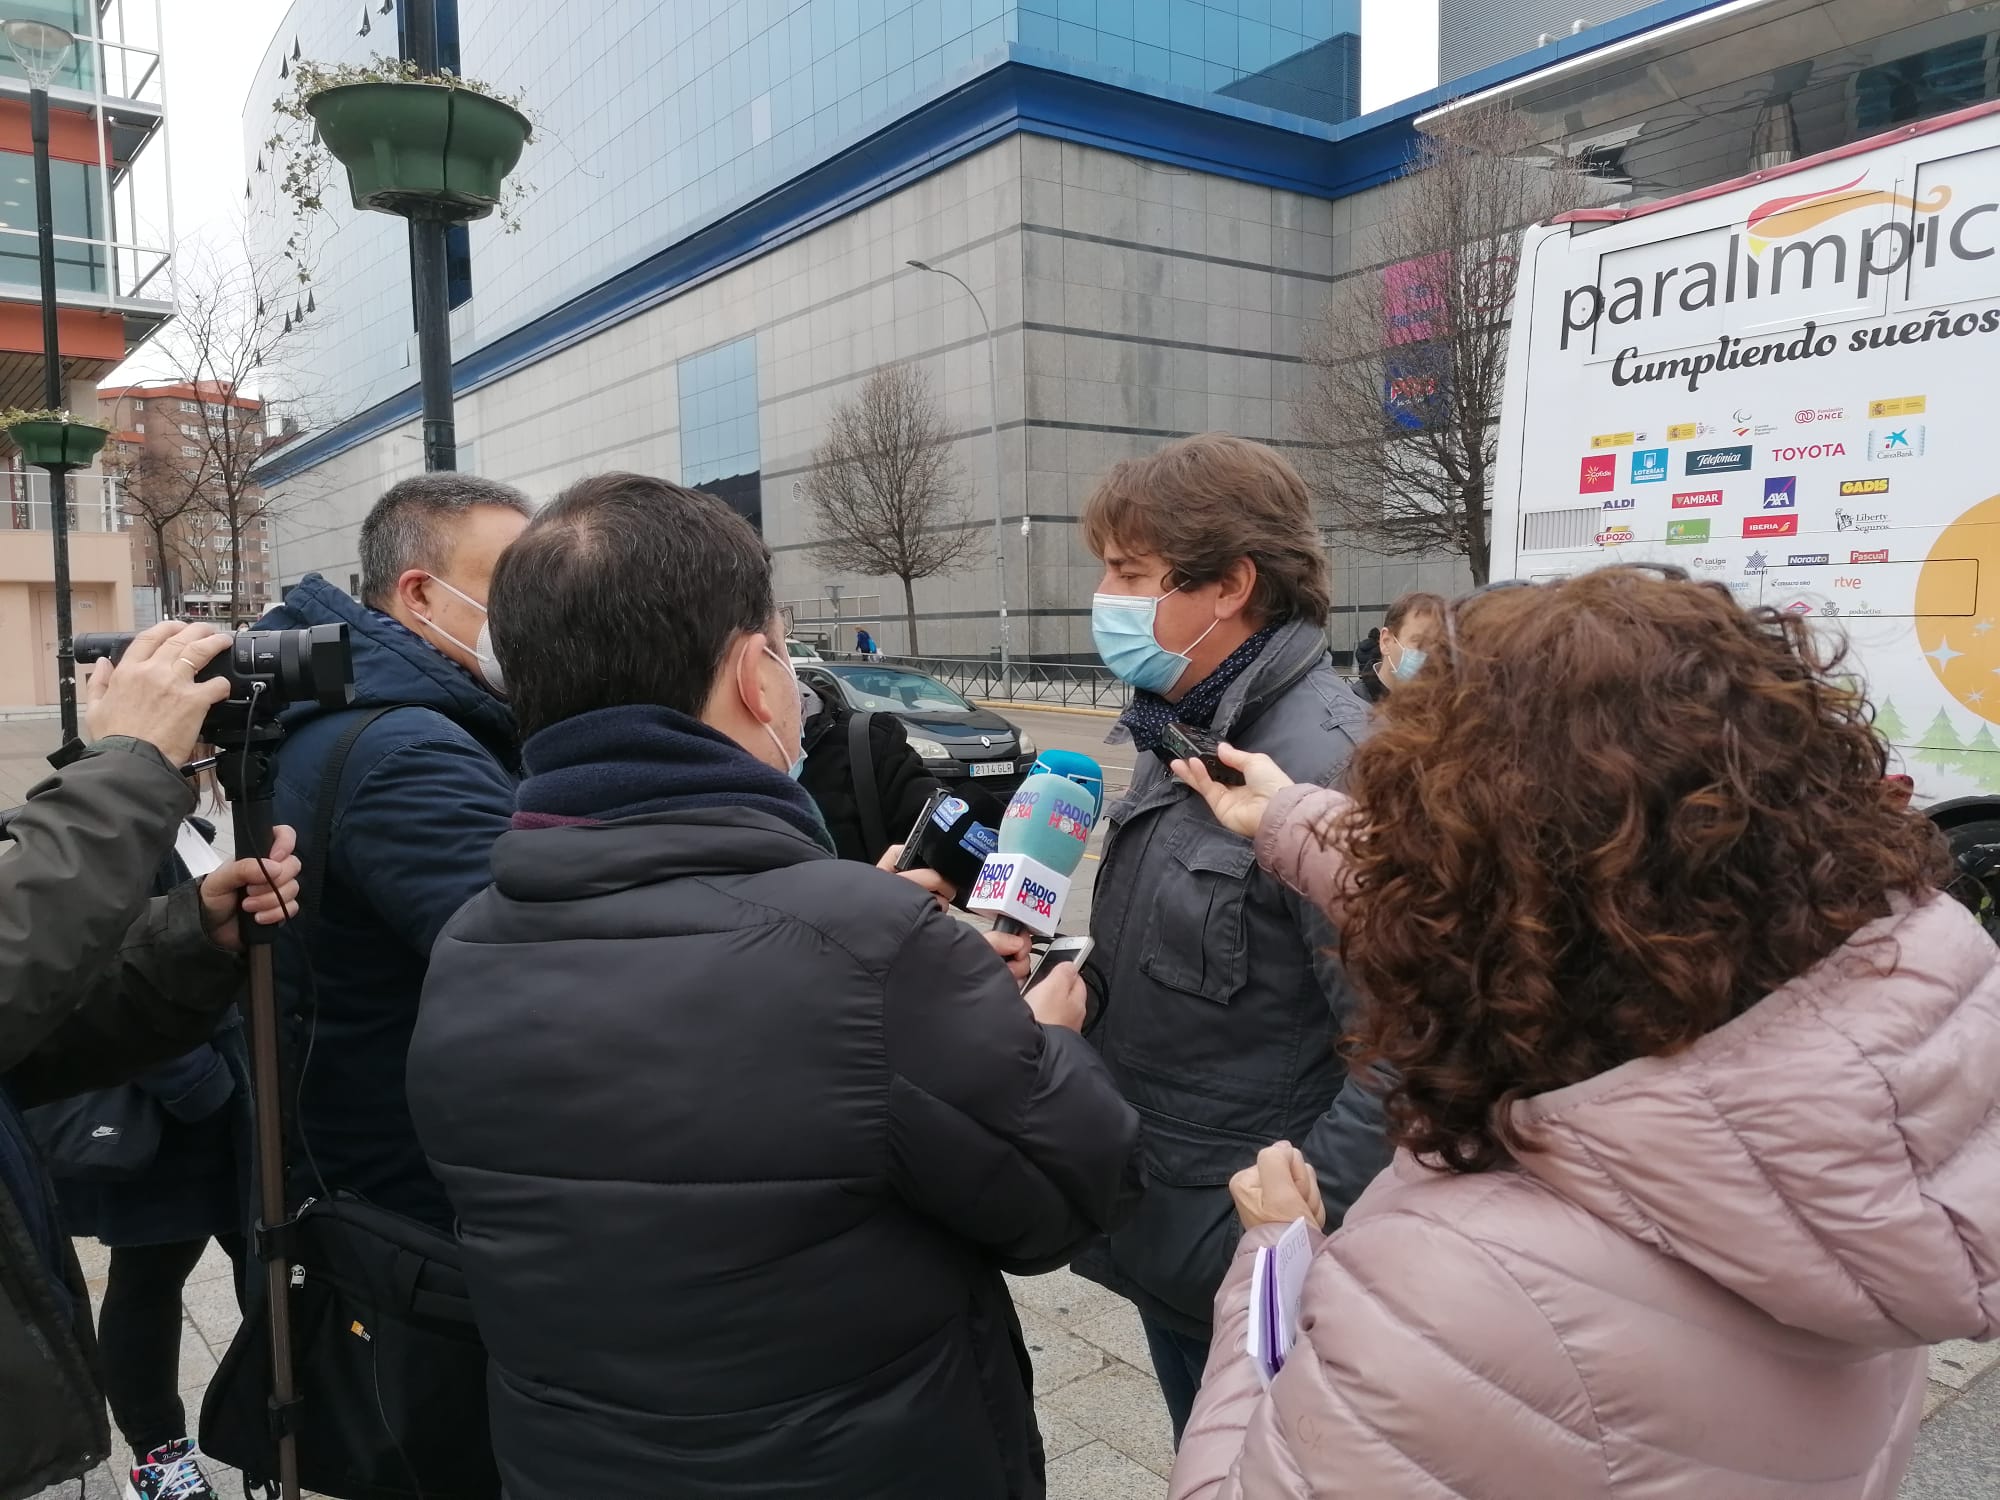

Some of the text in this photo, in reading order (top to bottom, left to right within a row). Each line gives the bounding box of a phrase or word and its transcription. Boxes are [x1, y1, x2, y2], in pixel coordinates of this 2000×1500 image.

[1612, 308, 2000, 391] Cumpliendo sueños
[1817, 411, 1843, 421] ONCE
[1772, 442, 1846, 462] TOYOTA
[1876, 450, 1914, 460] CaixaBank
[1696, 452, 1741, 467] Telefónica
[1841, 479, 1888, 494] GADIS
[1602, 498, 1635, 510] ALDI
[1683, 493, 1719, 505] AMBAR
[1763, 492, 1790, 506] AXA
[1855, 513, 1889, 522] Liberty
[1749, 523, 1779, 531] IBERIA
[1855, 523, 1890, 534] Seguros
[1789, 555, 1828, 564] Norauto
[1852, 551, 1887, 561] Pascual
[1834, 576, 1862, 589] rtve
[975, 764, 997, 775] 2114
[1053, 798, 1091, 828] RADIO
[976, 830, 996, 848] Onda
[979, 863, 1014, 881] RADIO
[1021, 876, 1057, 905] RADIO
